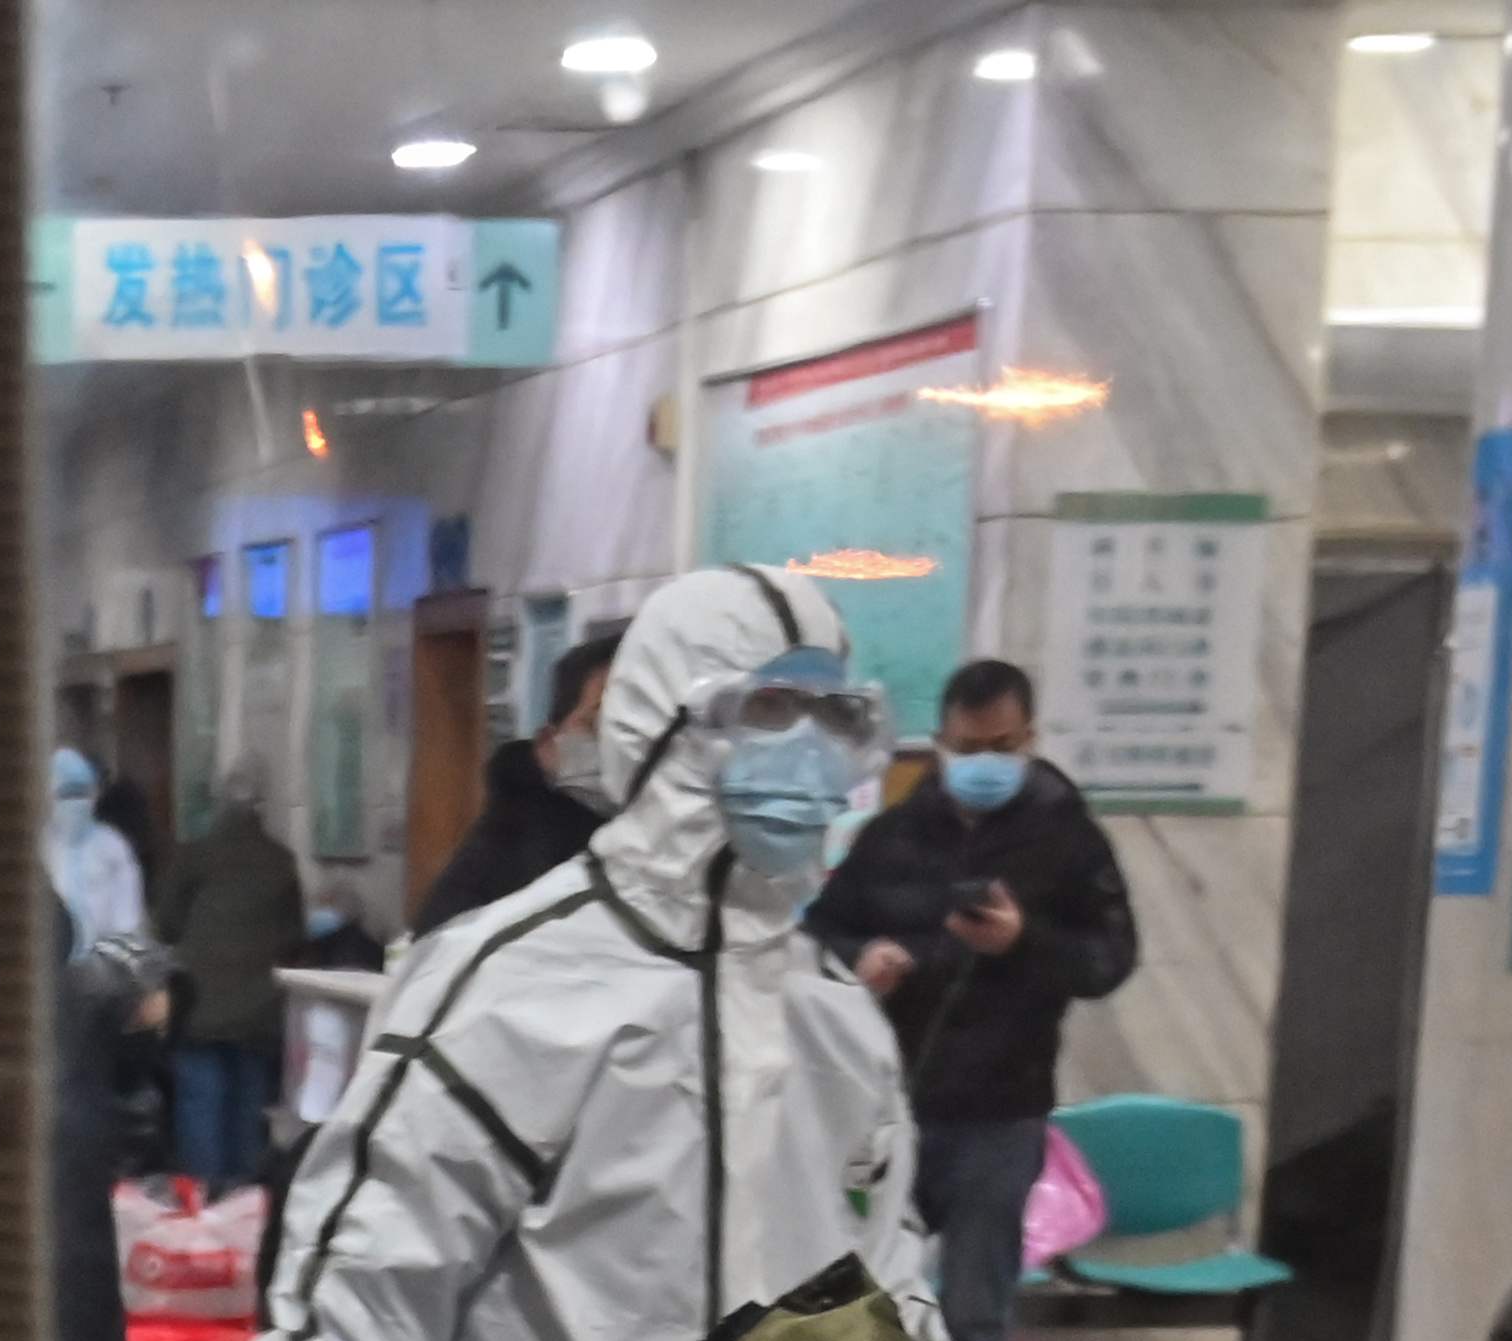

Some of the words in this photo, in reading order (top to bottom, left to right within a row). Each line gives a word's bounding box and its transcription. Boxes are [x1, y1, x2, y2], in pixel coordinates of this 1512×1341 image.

[101, 241, 429, 328] 发热门诊区
